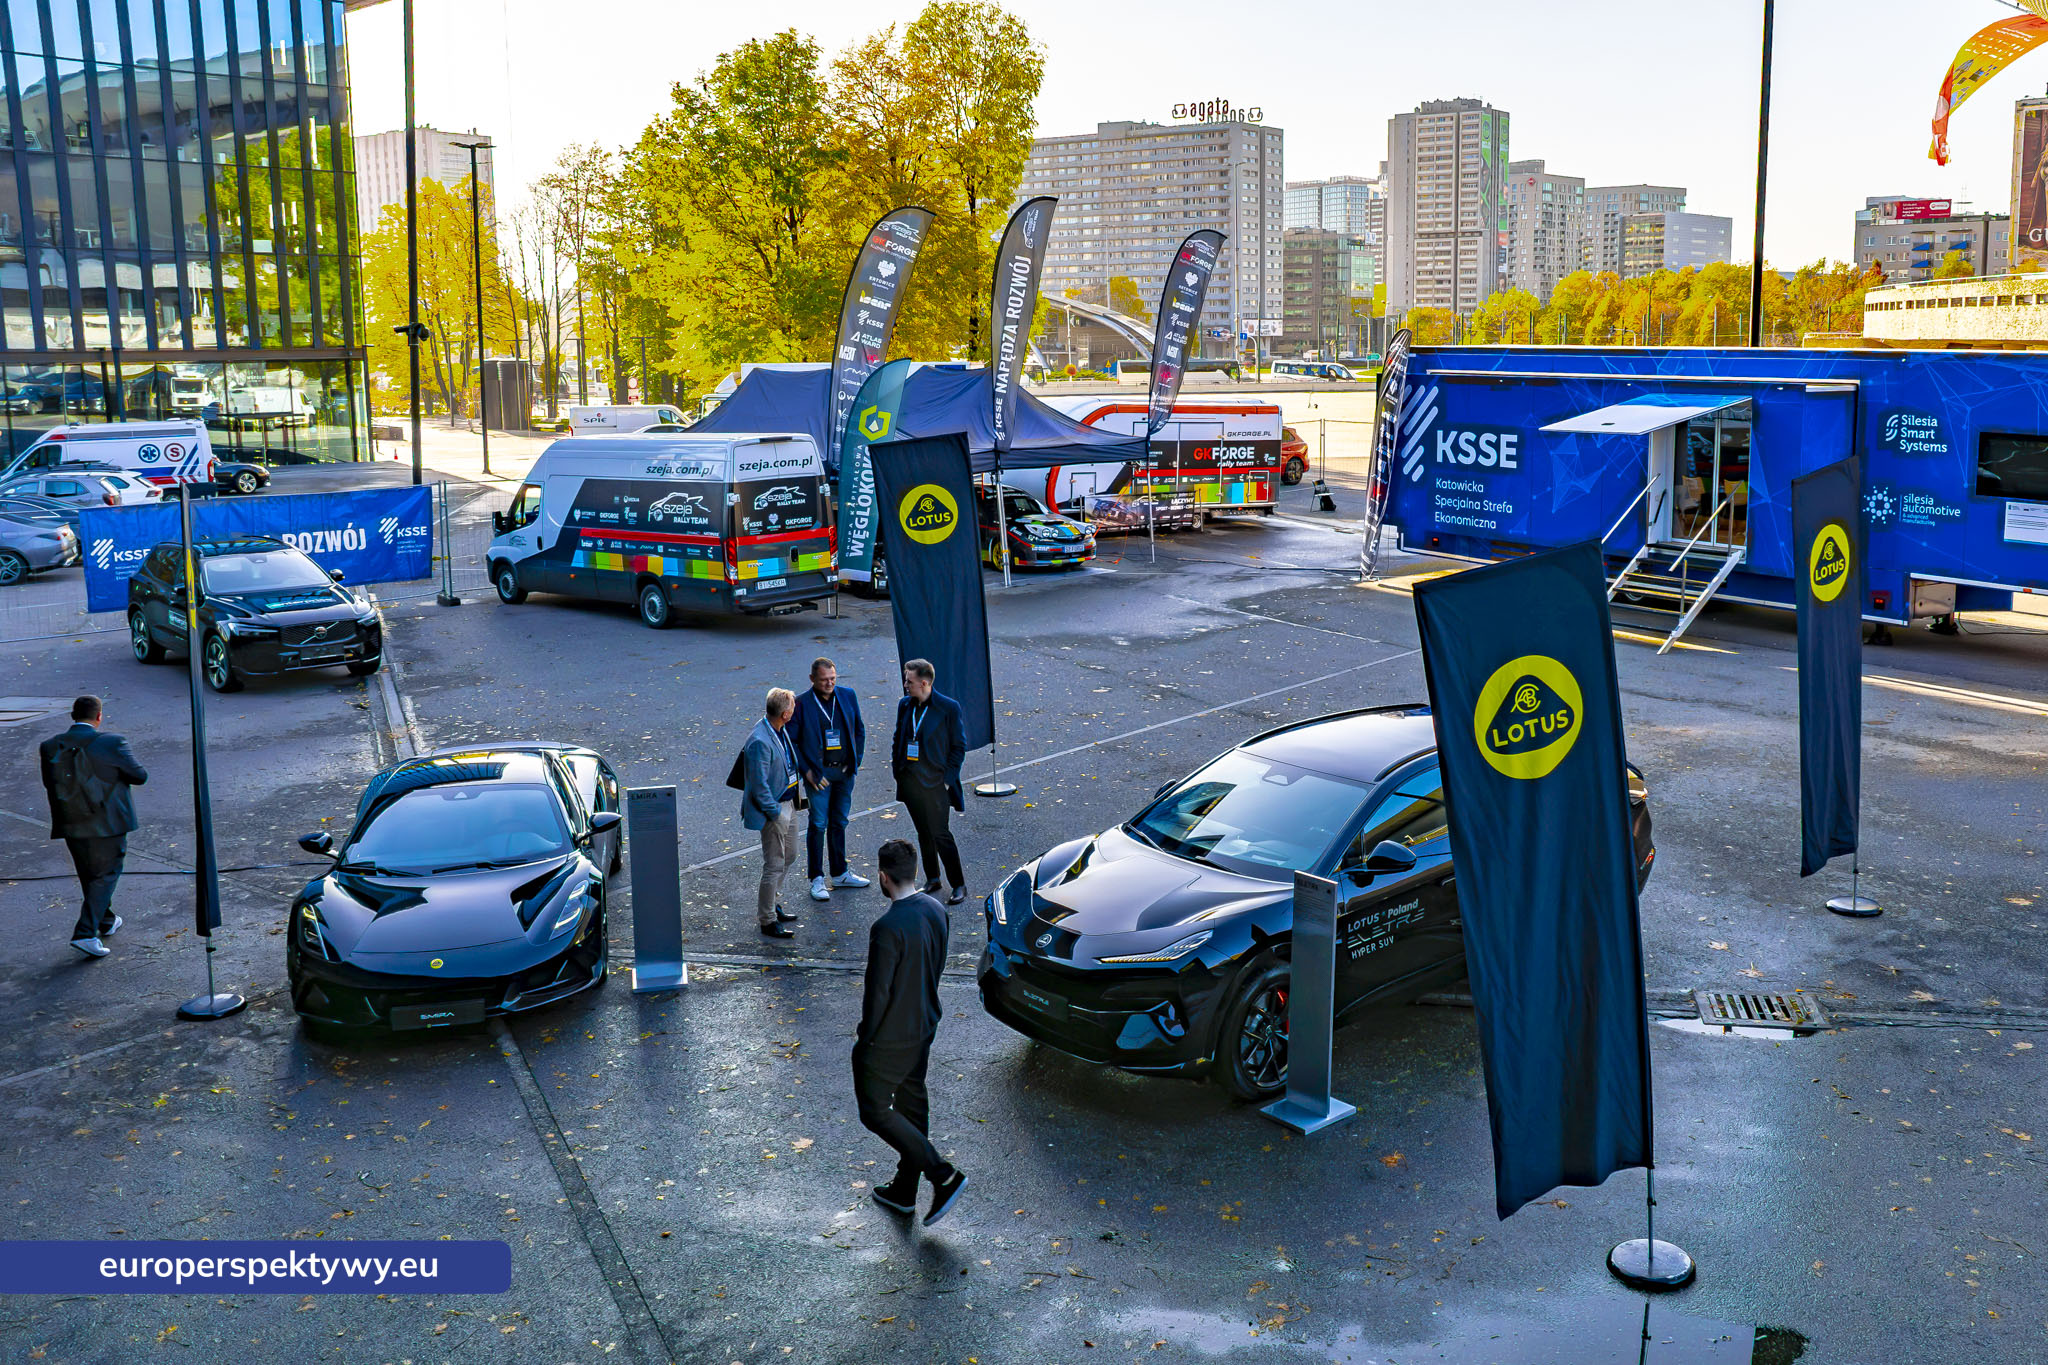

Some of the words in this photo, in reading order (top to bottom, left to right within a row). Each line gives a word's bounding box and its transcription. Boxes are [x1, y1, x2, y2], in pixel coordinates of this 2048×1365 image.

[1190, 97, 1229, 122] agata
[872, 235, 918, 259] GKFORGE
[1006, 255, 1031, 320] ROZWÓJ
[866, 318, 885, 329] KSSE
[861, 333, 882, 344] ATLAS
[861, 339, 881, 349] WARD
[995, 324, 1019, 394] NAPĘDZA
[583, 415, 607, 423] SPIE
[995, 397, 1003, 428] KSSE
[1901, 414, 1938, 427] Silesia
[1227, 430, 1272, 438] GKFORGE.PL
[1900, 427, 1936, 439] Smart
[169, 447, 181, 458] S
[1193, 446, 1255, 461] GKFORGE
[1436, 429, 1518, 469] KSSE
[1899, 440, 1948, 453] Systems
[645, 463, 715, 478] szeja.com.pl
[739, 455, 813, 473] szeja.com.pl
[1217, 460, 1235, 468] rally
[1435, 477, 1484, 493] Katowicka
[767, 491, 793, 502] szeja
[1435, 494, 1481, 511] Specjalna
[1483, 499, 1513, 513] Strefa
[1903, 493, 1934, 506] silesia
[663, 500, 693, 517] szeja
[1902, 504, 1961, 517] automotive
[673, 516, 690, 524] RALLY
[691, 516, 709, 525] TEAM
[748, 520, 763, 528] KSSE
[785, 516, 812, 526] GKFORGE
[909, 511, 951, 528] LOTUS
[1434, 511, 1497, 529] Ekonomiczna
[282, 522, 367, 554] ROZWÓJ
[396, 526, 428, 538] KSSE
[1815, 558, 1845, 582] LOTUS
[1492, 709, 1569, 748] LOTUS
[1347, 911, 1380, 933] LOTUS
[1387, 897, 1419, 919] Poland
[1351, 942, 1377, 960] HYPER
[1379, 935, 1395, 949] SUV
